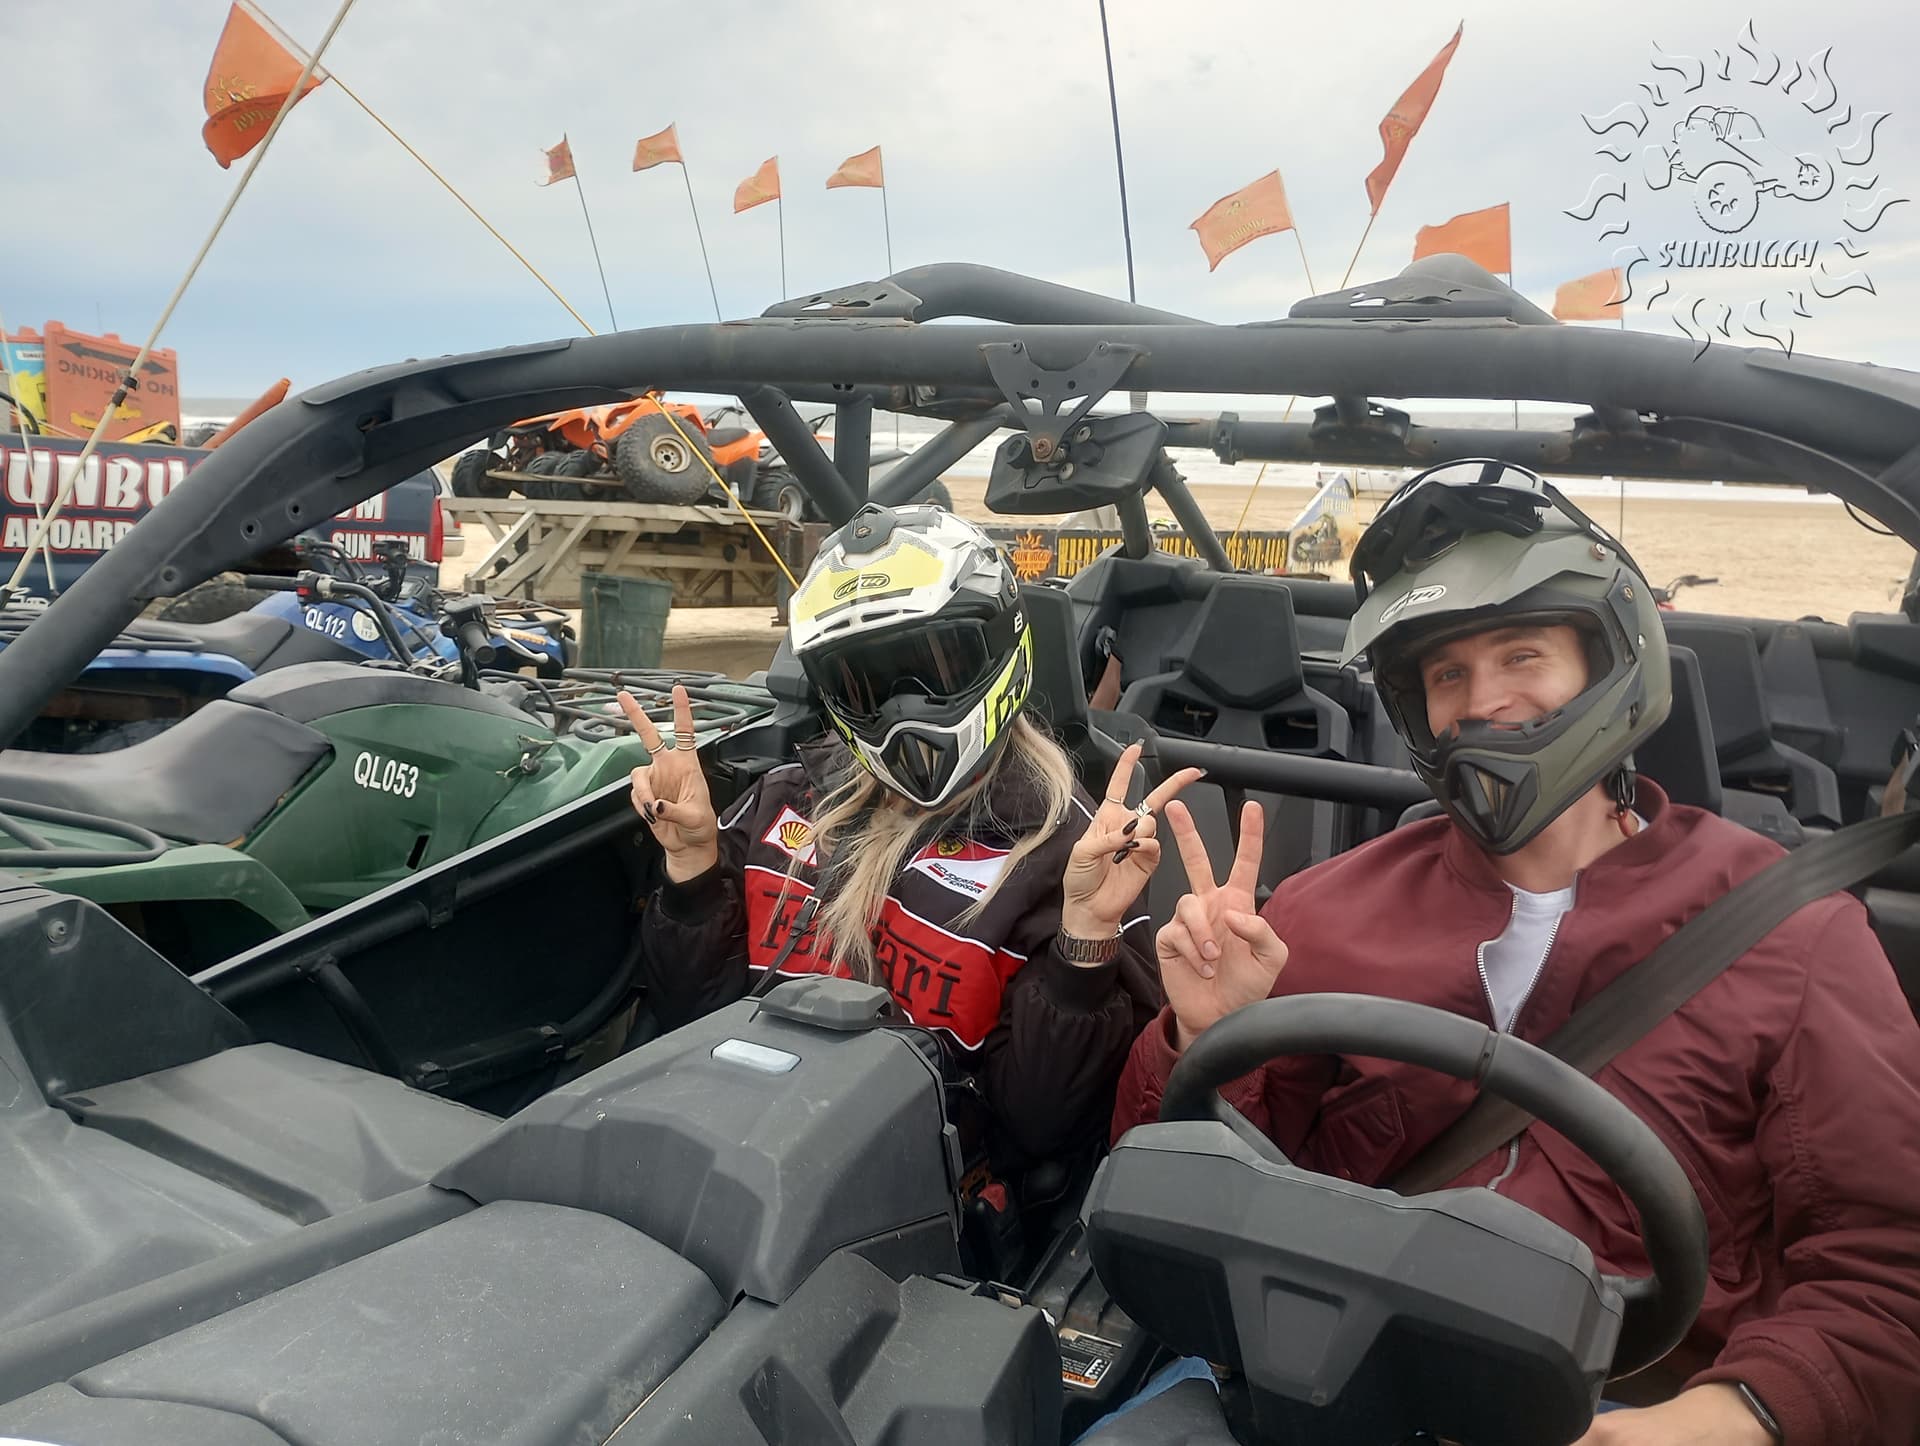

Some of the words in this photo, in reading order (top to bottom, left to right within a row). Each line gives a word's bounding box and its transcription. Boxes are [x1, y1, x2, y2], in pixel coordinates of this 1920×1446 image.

[59, 360, 139, 390] ARKING
[147, 382, 174, 397] NO
[332, 532, 372, 559] SUN
[305, 608, 347, 639] QL112
[353, 751, 419, 798] QL053
[760, 890, 962, 1016] Fari
